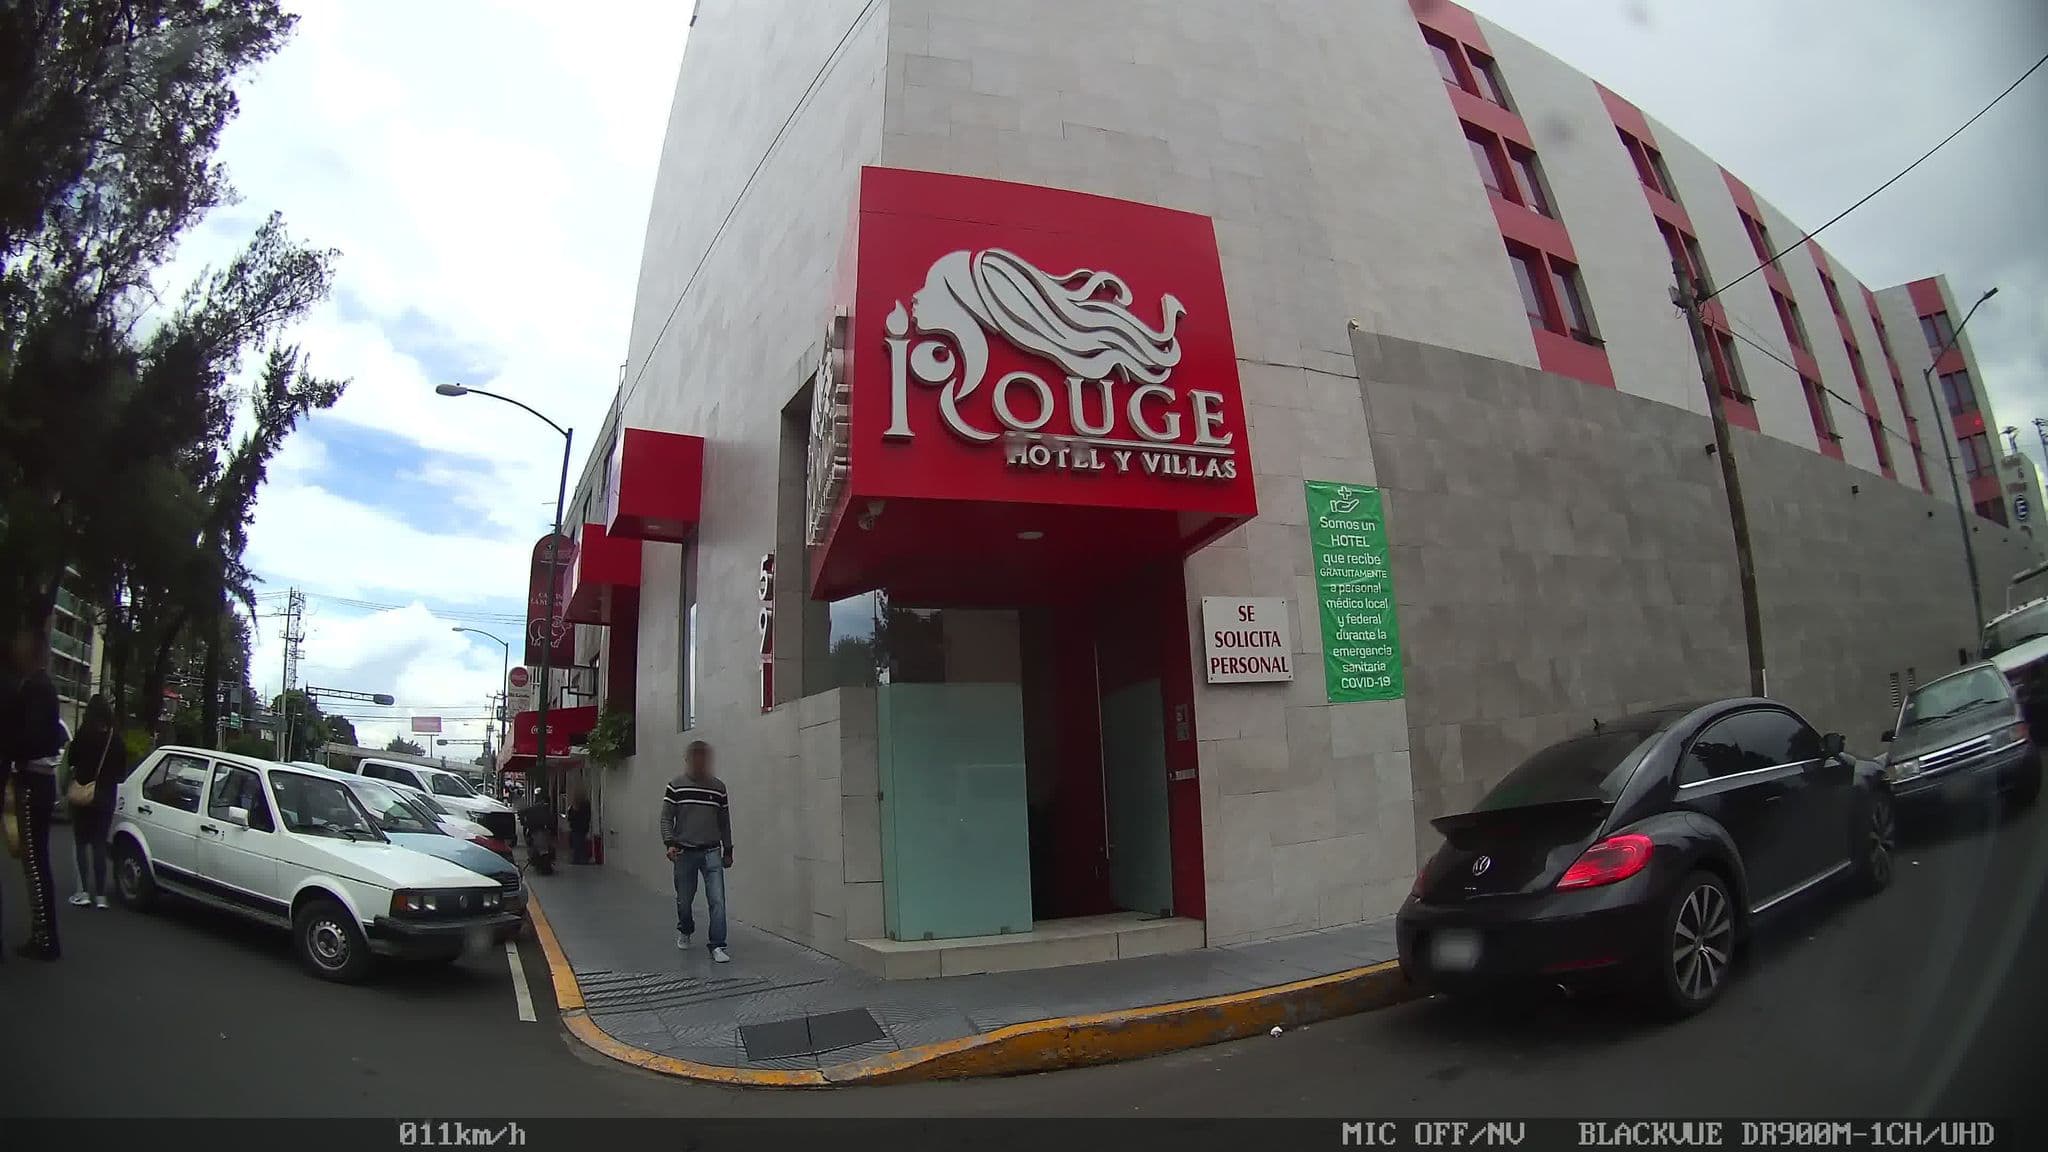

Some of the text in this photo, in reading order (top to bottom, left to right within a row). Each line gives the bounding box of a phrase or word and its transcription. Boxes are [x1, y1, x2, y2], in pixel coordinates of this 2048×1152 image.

[884, 325, 1234, 446] ROUGE
[1113, 450, 1132, 471] Y
[1142, 452, 1237, 479] VILLAS
[1320, 516, 1376, 531] Somos un
[1331, 534, 1370, 547] HOTEL
[1323, 553, 1381, 566] que recibe
[1320, 568, 1387, 578] GRATUITAMENTE
[1330, 583, 1382, 596] a personal
[1326, 597, 1388, 609] médico local
[1238, 605, 1255, 622] SE
[1337, 613, 1382, 628] y federal
[1214, 631, 1281, 648] SOLICITA
[1336, 629, 1387, 641] durante la
[1333, 645, 1392, 659] emergencia
[1210, 656, 1289, 674] PERSONAL
[1342, 661, 1387, 673] sanitaria
[1341, 676, 1391, 690] COVID-19
